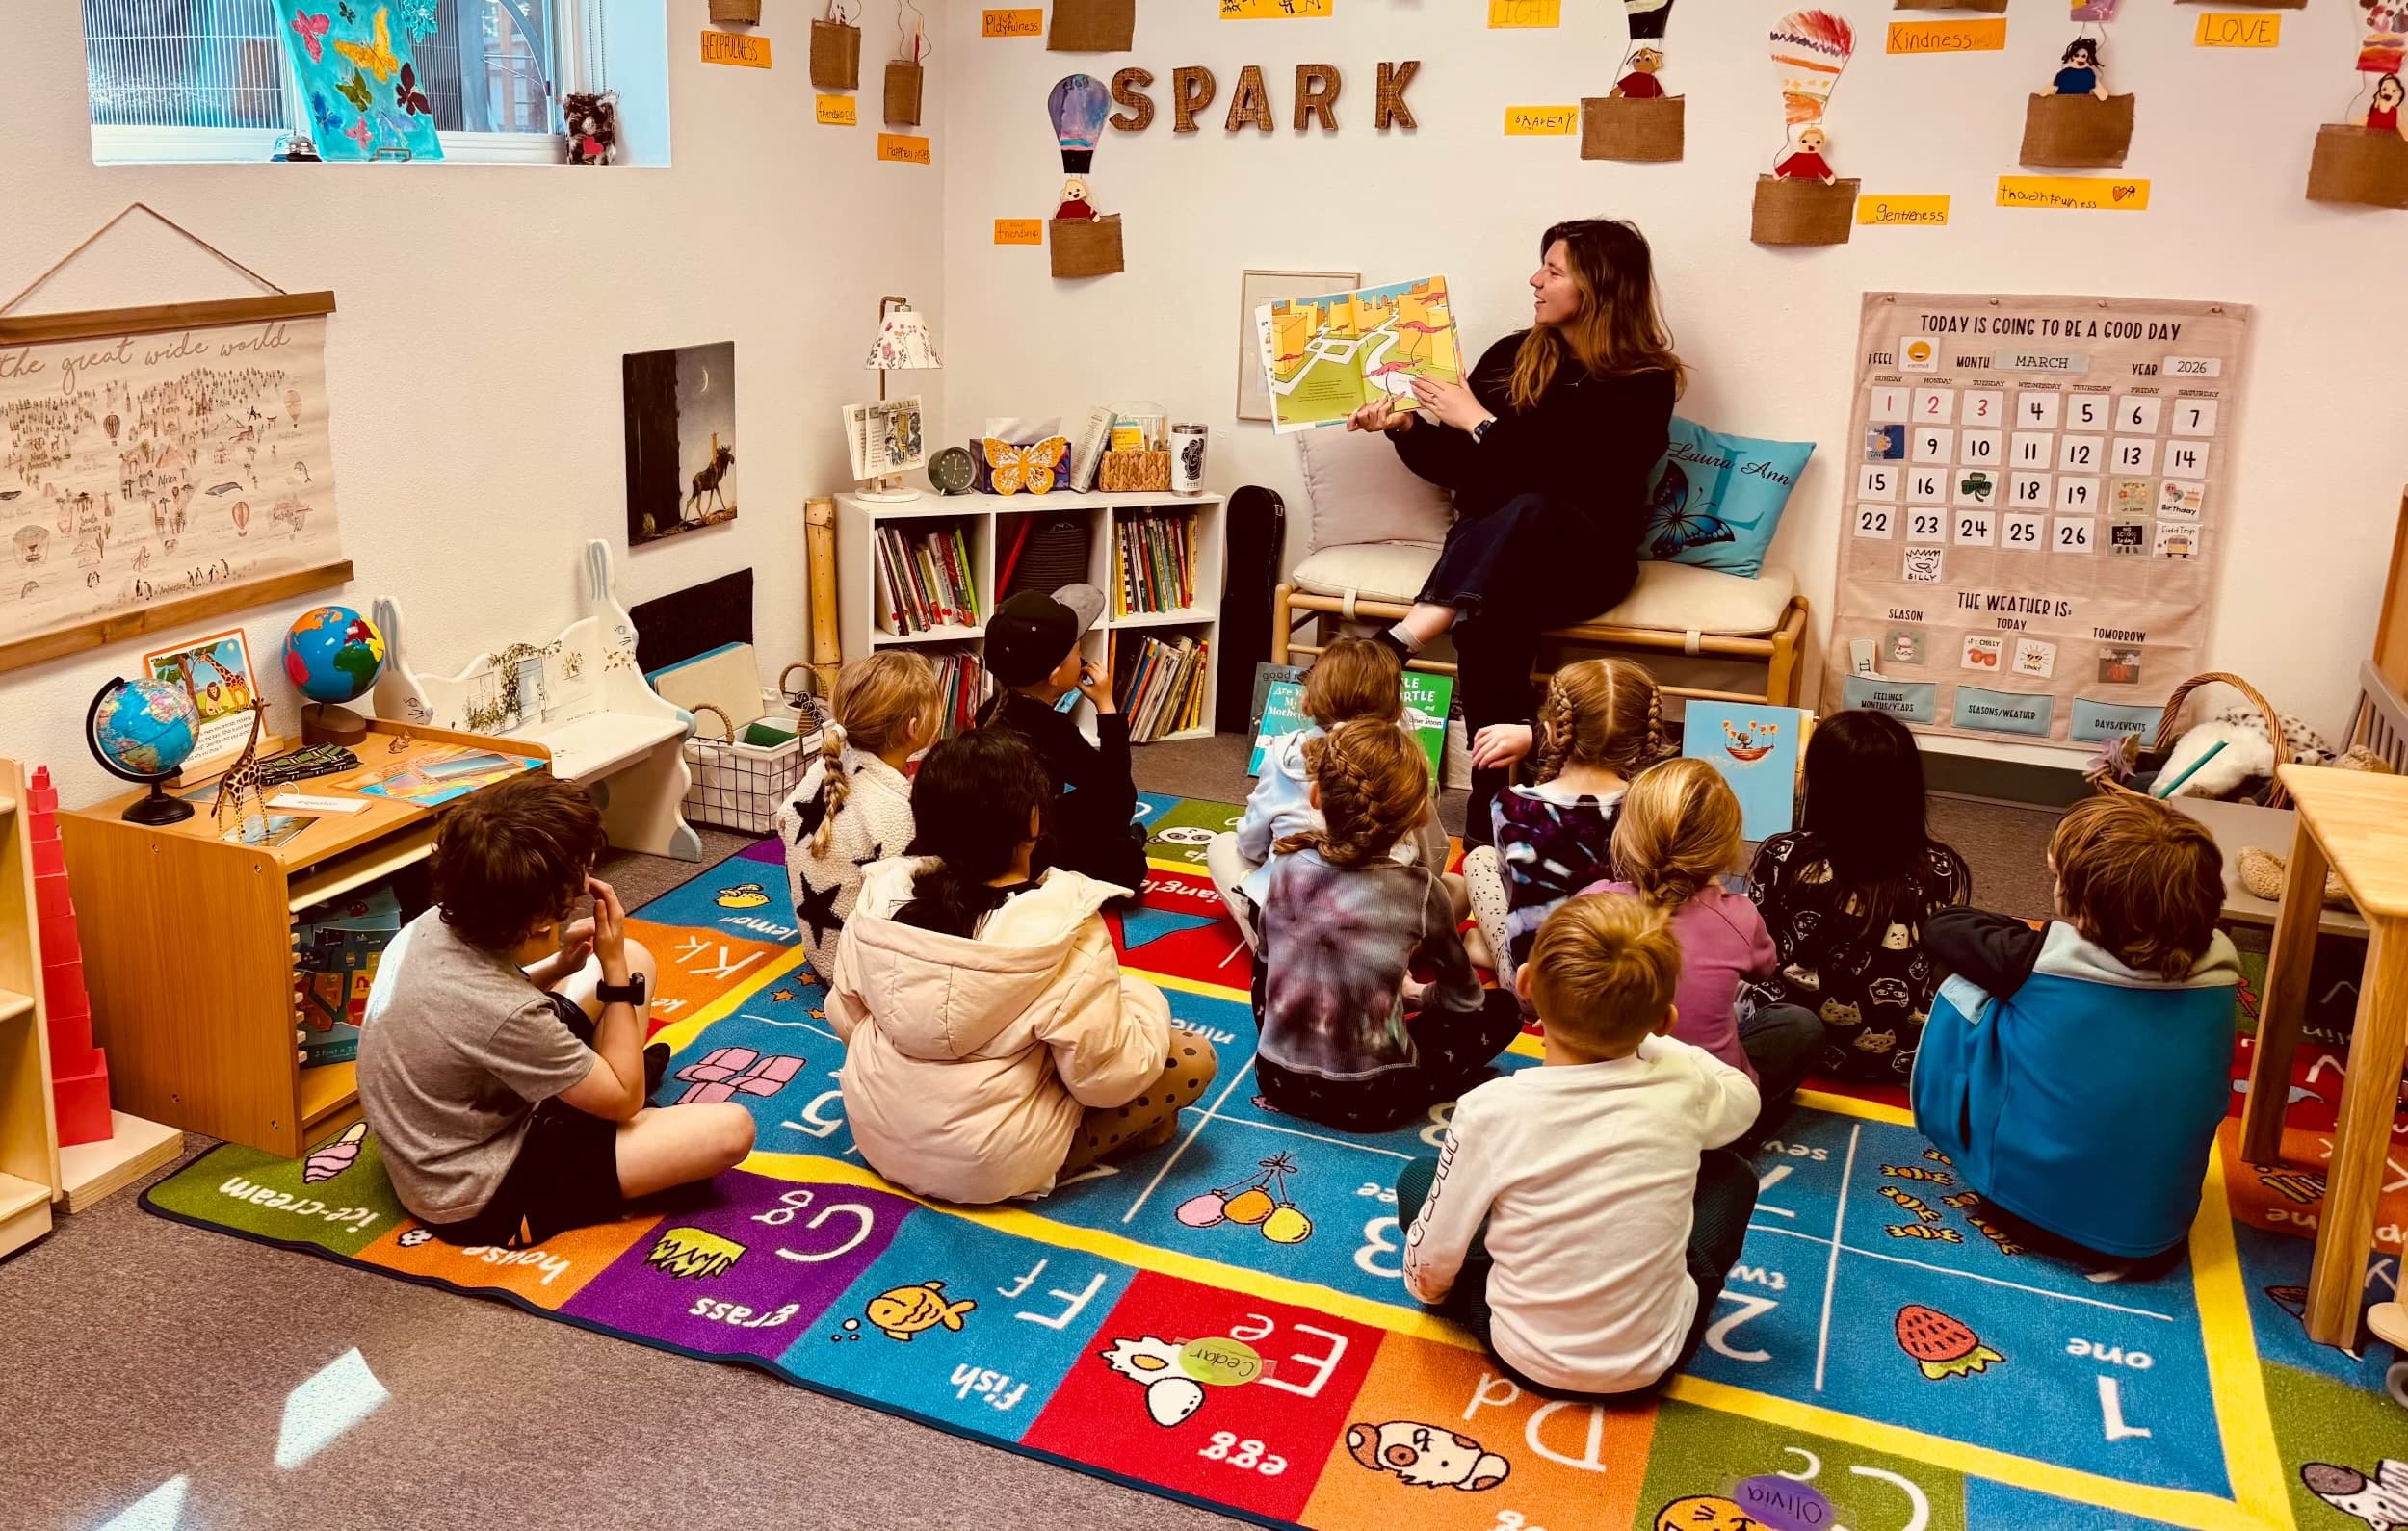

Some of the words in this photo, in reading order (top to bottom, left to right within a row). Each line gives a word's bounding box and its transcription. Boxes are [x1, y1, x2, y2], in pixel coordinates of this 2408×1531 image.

[1891, 26, 1973, 50] Kindness
[2204, 13, 2272, 43] LOVE
[1109, 60, 1421, 132] SPARK
[1921, 314, 1970, 333] TODAY
[1974, 316, 1987, 334] IS
[1992, 317, 2035, 335] GOING
[2042, 318, 2059, 336] TO
[2064, 320, 2082, 337] BE
[2087, 321, 2097, 338] A
[2104, 321, 2142, 340] GOOD
[2148, 323, 2182, 341] DAY
[61, 336, 135, 396] great
[144, 332, 209, 366] wide
[220, 322, 292, 357] world
[1873, 351, 1893, 366] FEEL
[1956, 355, 1990, 370] MONTH
[2014, 354, 2069, 370] MARCH
[2132, 363, 2158, 376] YEAR
[2177, 360, 2207, 374] 2026
[1924, 376, 1953, 385] MONDAY
[1972, 379, 2005, 388] TUESDAY
[2018, 381, 2062, 390] WEDNESDAY
[2072, 384, 2112, 393] THURSDAY
[2178, 389, 2220, 398] SATURDAY
[1886, 395, 1892, 412] 1
[1927, 396, 1939, 414] 2
[1977, 399, 1988, 417] 3
[2030, 402, 2044, 421] 4
[2081, 403, 2093, 423] 5
[2132, 406, 2142, 425] 6
[2189, 409, 2200, 428] 7
[1668, 442, 1733, 470] Laura
[1741, 461, 1790, 485] Ann
[1927, 438, 1937, 455] 9
[1971, 440, 1990, 456] 10
[2025, 442, 2037, 460] 11
[2070, 445, 2090, 464] 12
[2123, 446, 2142, 465] 13
[2175, 449, 2197, 468] 14
[1868, 473, 1886, 491] 15
[1918, 477, 1935, 495] 16
[2020, 481, 2040, 500] 18
[2067, 485, 2086, 505] 19
[2161, 504, 2197, 516] Birthday
[1861, 512, 1888, 532] 22
[1914, 515, 1938, 534] 23
[1961, 519, 1987, 538] 24
[2010, 523, 2035, 542] 25
[2060, 526, 2086, 545] 26
[1907, 573, 1937, 582] SILLY
[1888, 608, 1924, 622] SEASON
[1957, 591, 1981, 610] THE
[1986, 594, 2051, 616] WEATHER
[2055, 601, 2072, 617] IS:
[1997, 617, 2028, 631] TODAY
[2092, 627, 2147, 643] TOMORROW
[1262, 669, 1291, 682] good
[1272, 685, 1293, 696] Are
[1873, 691, 1903, 702] FEELINGS
[1860, 701, 1914, 713] MONTHS/YEARS
[1968, 704, 2036, 720] SEASONS/WEATHER
[2094, 719, 2147, 733] DAYS/EVENTS
[717, 914, 799, 944] lemon
[218, 1174, 384, 1234] ice-cream
[1352, 1216, 1405, 1279] 3
[688, 1296, 802, 1329] grass
[1705, 1289, 1779, 1363] 2
[1188, 1349, 1255, 1380] Cedar
[2066, 1336, 2154, 1371] one
[950, 1362, 1030, 1412] fish
[2097, 1374, 2152, 1442] 1
[1197, 1431, 1290, 1475] egg
[1746, 1485, 1823, 1524] Olivia
